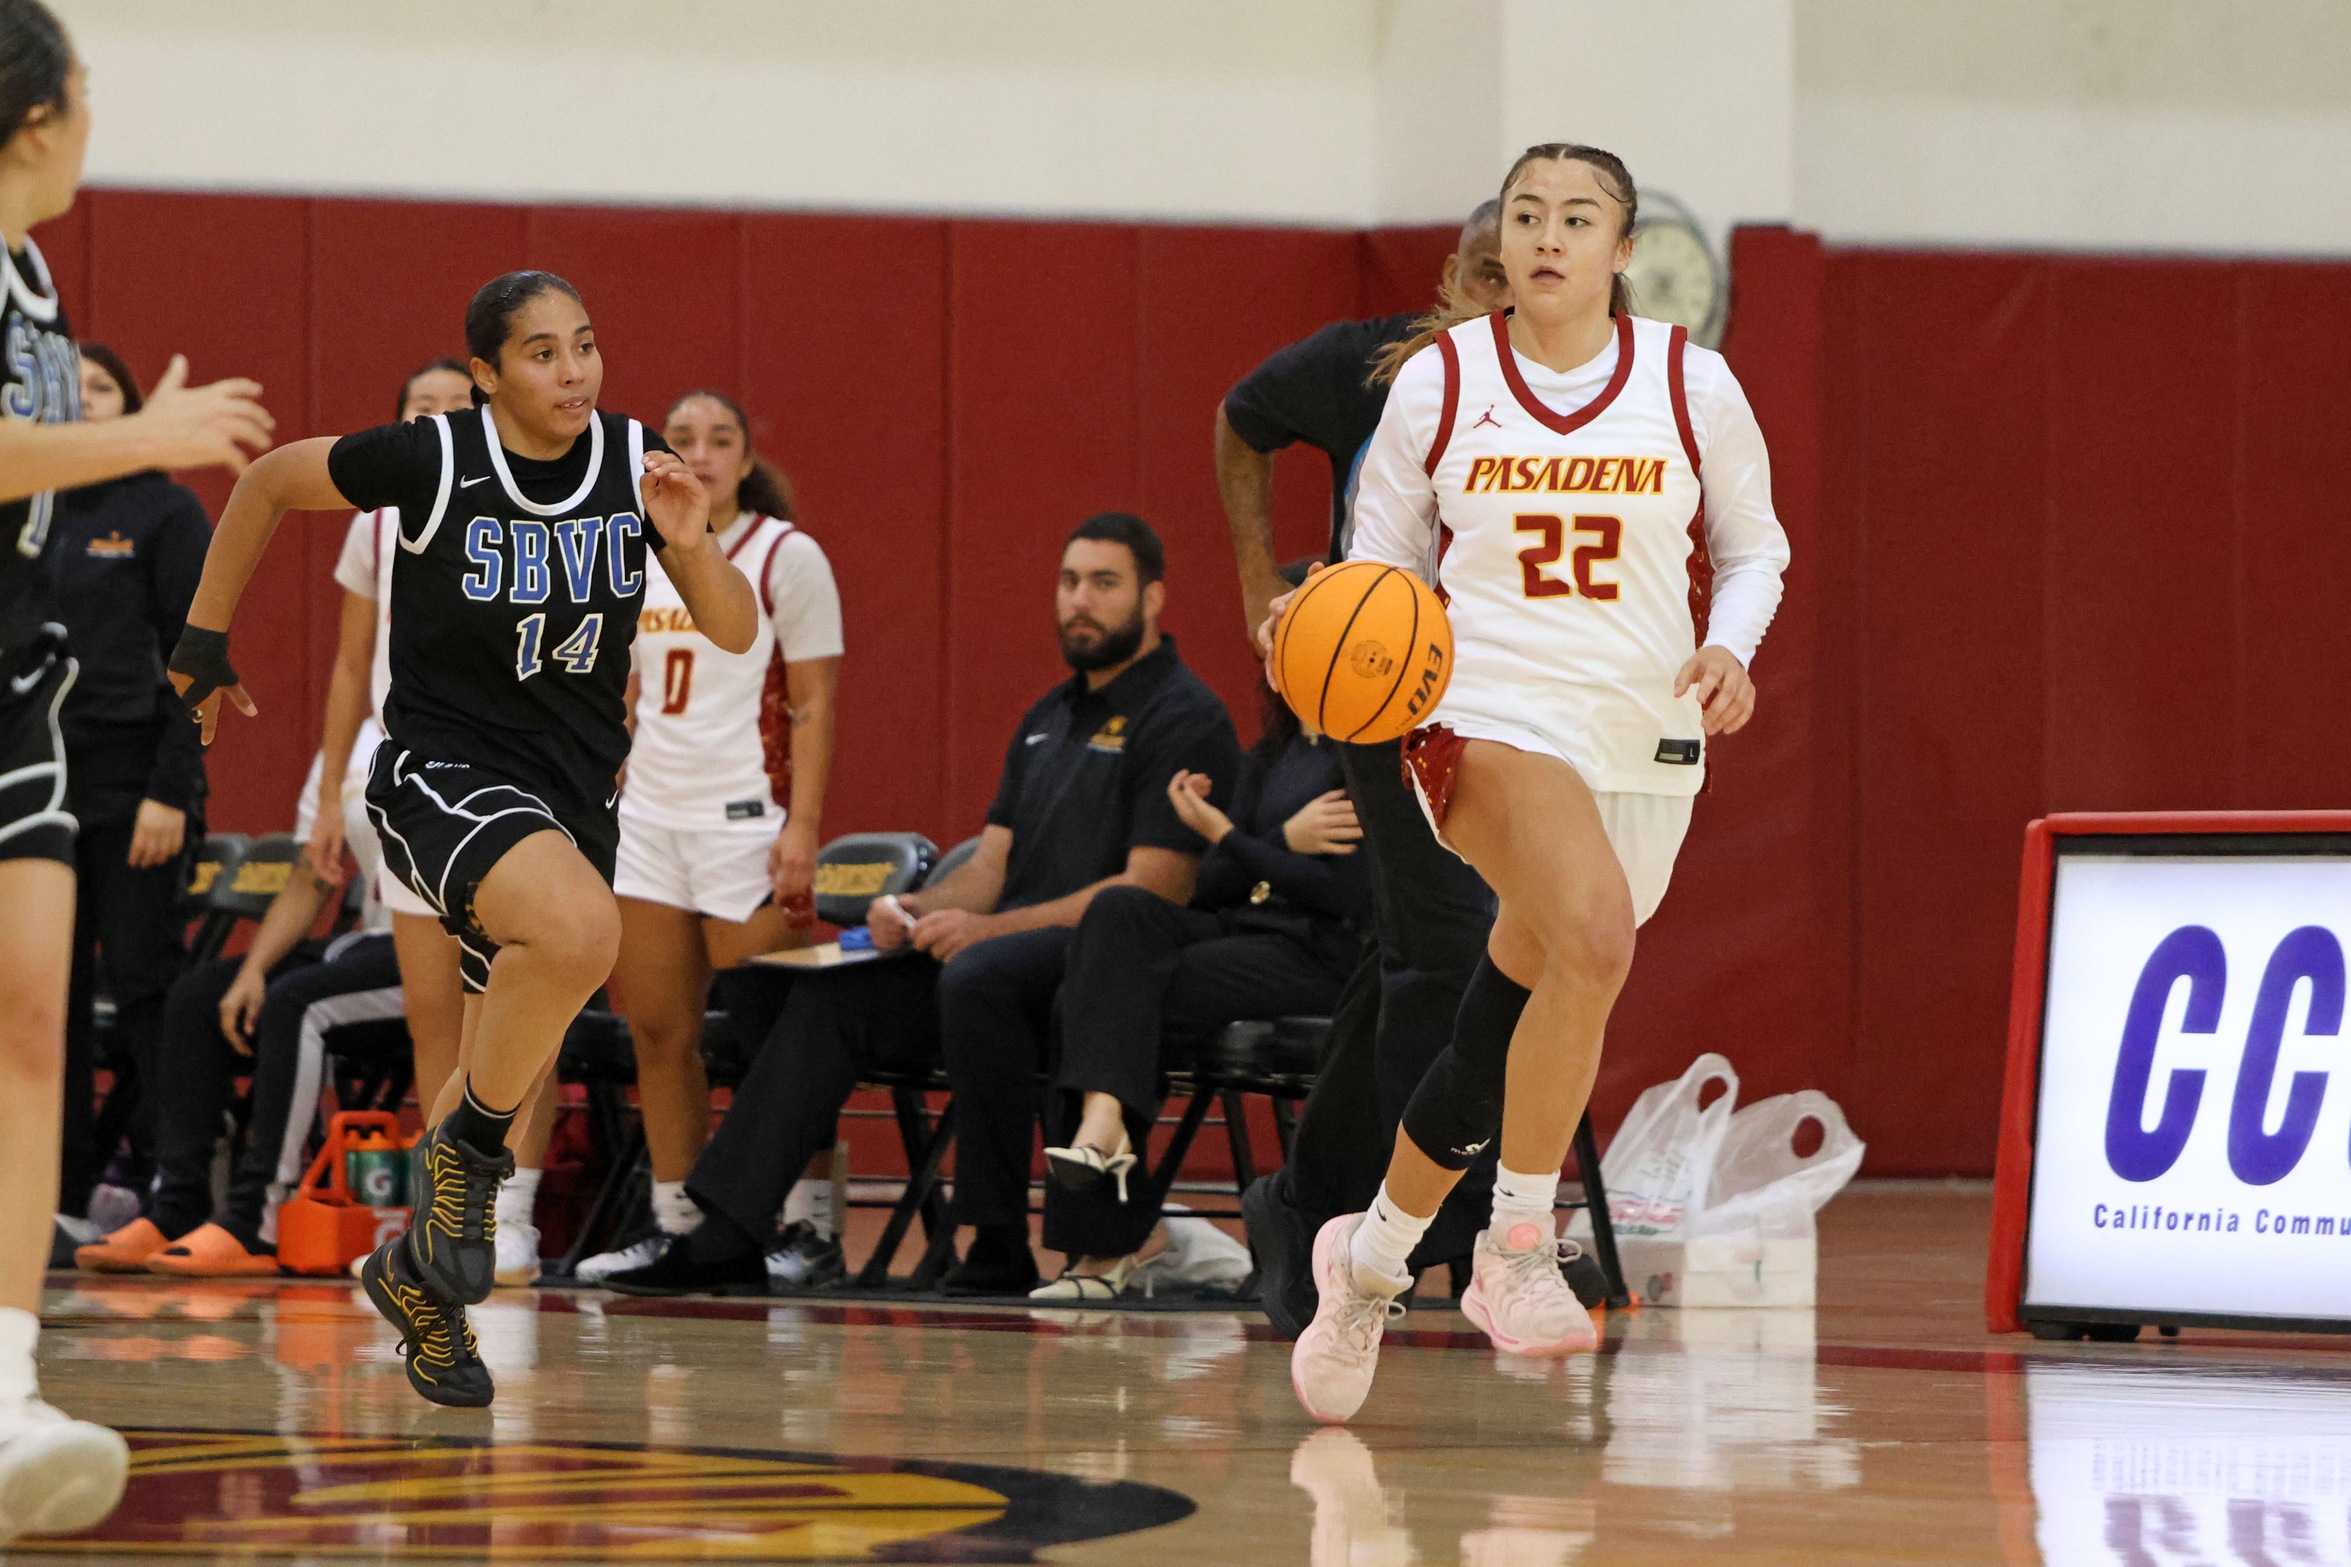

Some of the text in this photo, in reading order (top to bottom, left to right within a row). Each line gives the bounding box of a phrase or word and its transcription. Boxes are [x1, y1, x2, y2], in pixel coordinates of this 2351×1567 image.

[1462, 455, 1669, 495] PASADENA
[461, 511, 643, 604] SBVC
[1512, 512, 1624, 602] 22
[515, 612, 604, 682] 14
[661, 648, 696, 716] 0
[2104, 924, 2351, 1186] CC
[2093, 1203, 2351, 1236] California Commu
